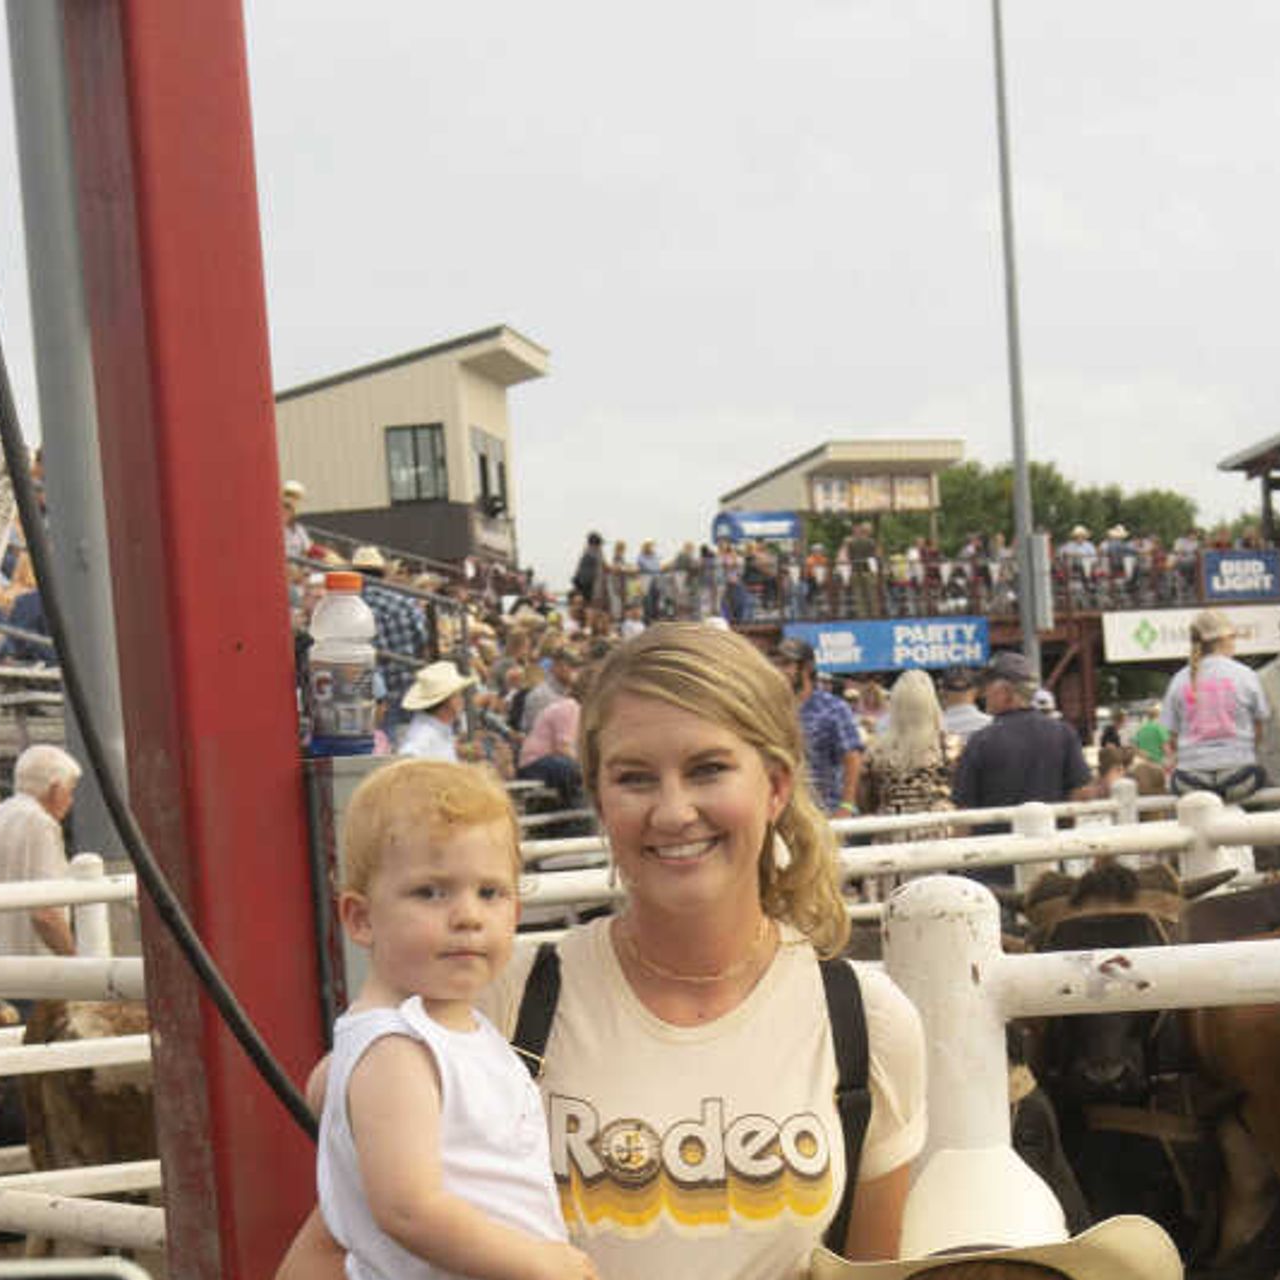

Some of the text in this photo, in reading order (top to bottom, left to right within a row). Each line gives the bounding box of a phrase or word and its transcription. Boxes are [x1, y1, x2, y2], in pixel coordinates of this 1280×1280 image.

[894, 624, 977, 644] PARTY
[894, 643, 983, 665] PORCH
[549, 1092, 831, 1188] Rodeo
